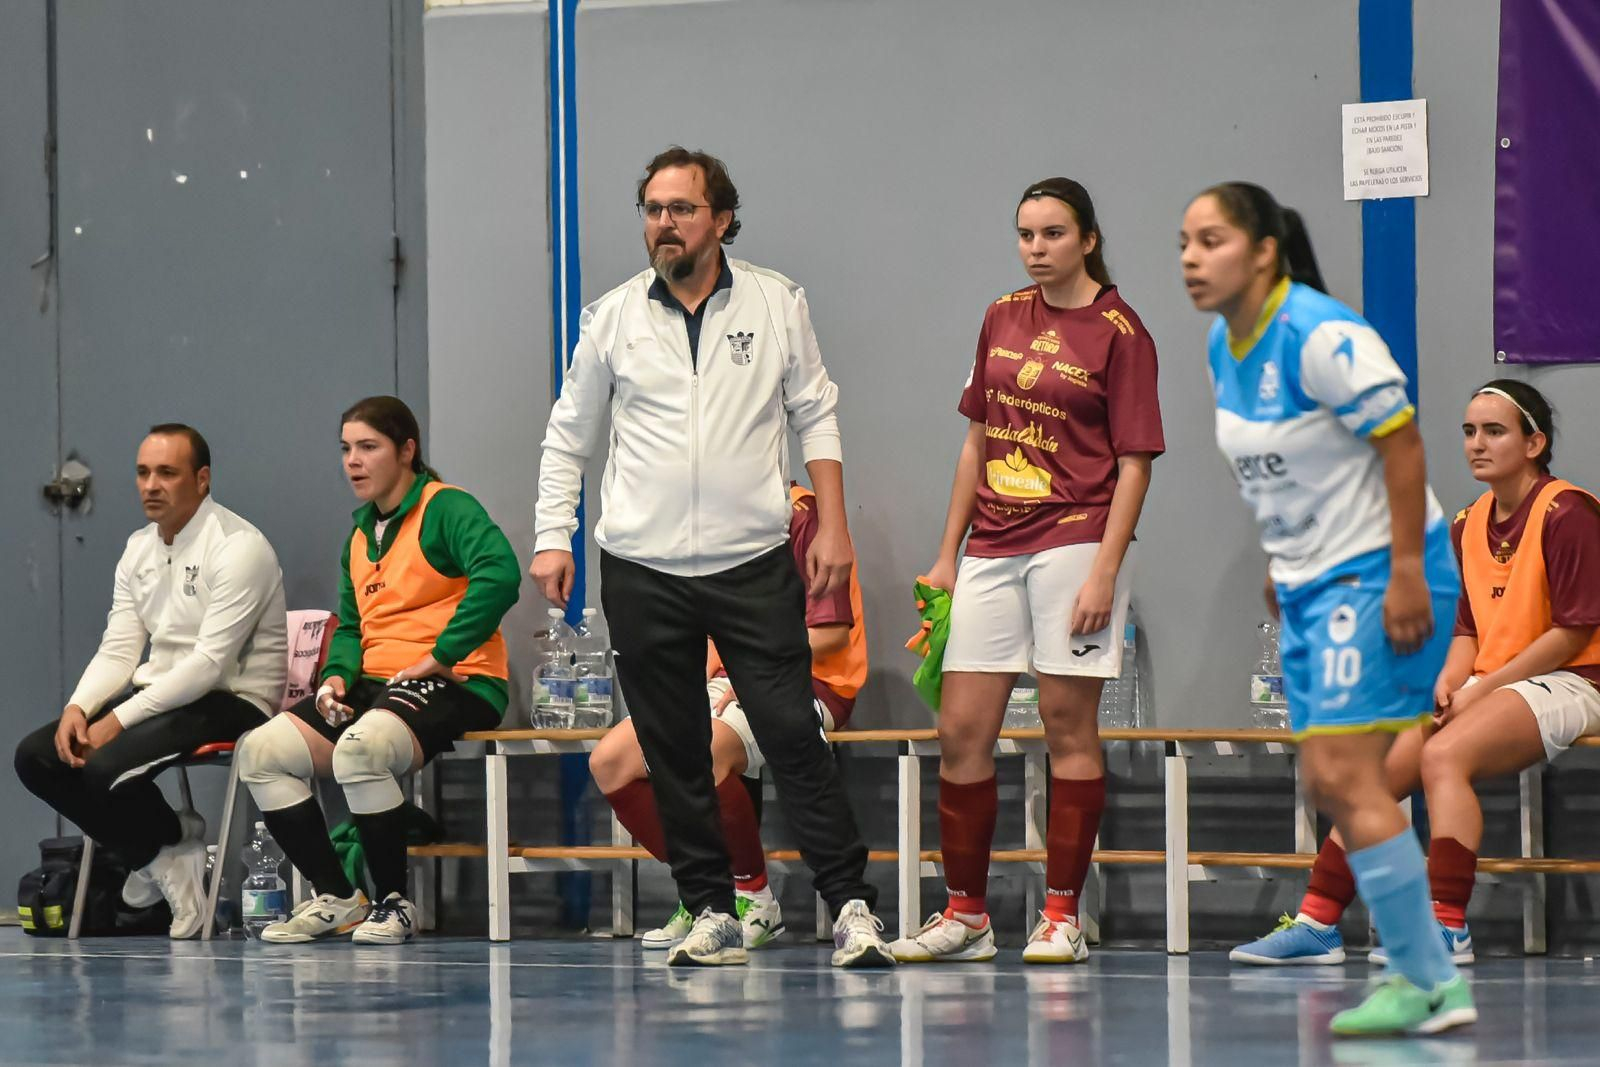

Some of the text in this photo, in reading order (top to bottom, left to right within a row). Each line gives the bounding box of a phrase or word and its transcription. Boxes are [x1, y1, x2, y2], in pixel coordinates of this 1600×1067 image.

[1399, 175, 1422, 183] SERVICIOS
[1051, 361, 1090, 381] NACEX
[997, 390, 1068, 420] federópticos
[1322, 647, 1362, 688] 10
